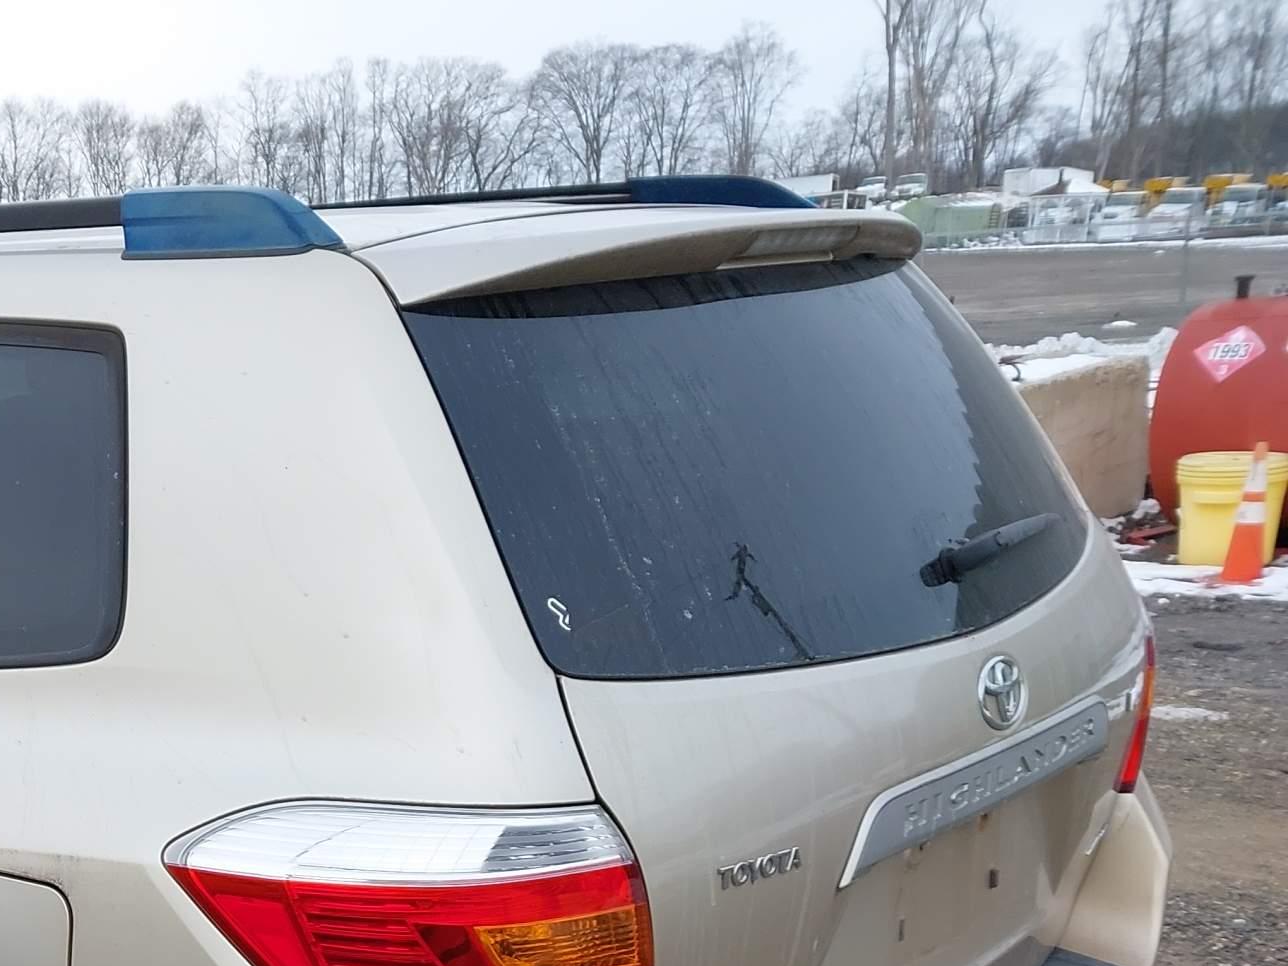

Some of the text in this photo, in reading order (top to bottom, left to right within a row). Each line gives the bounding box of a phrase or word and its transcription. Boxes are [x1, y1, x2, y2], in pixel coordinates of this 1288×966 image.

[1208, 343, 1250, 359] 1993
[903, 718, 1095, 837] HIGHLANDER
[717, 846, 800, 890] TOYOTA
